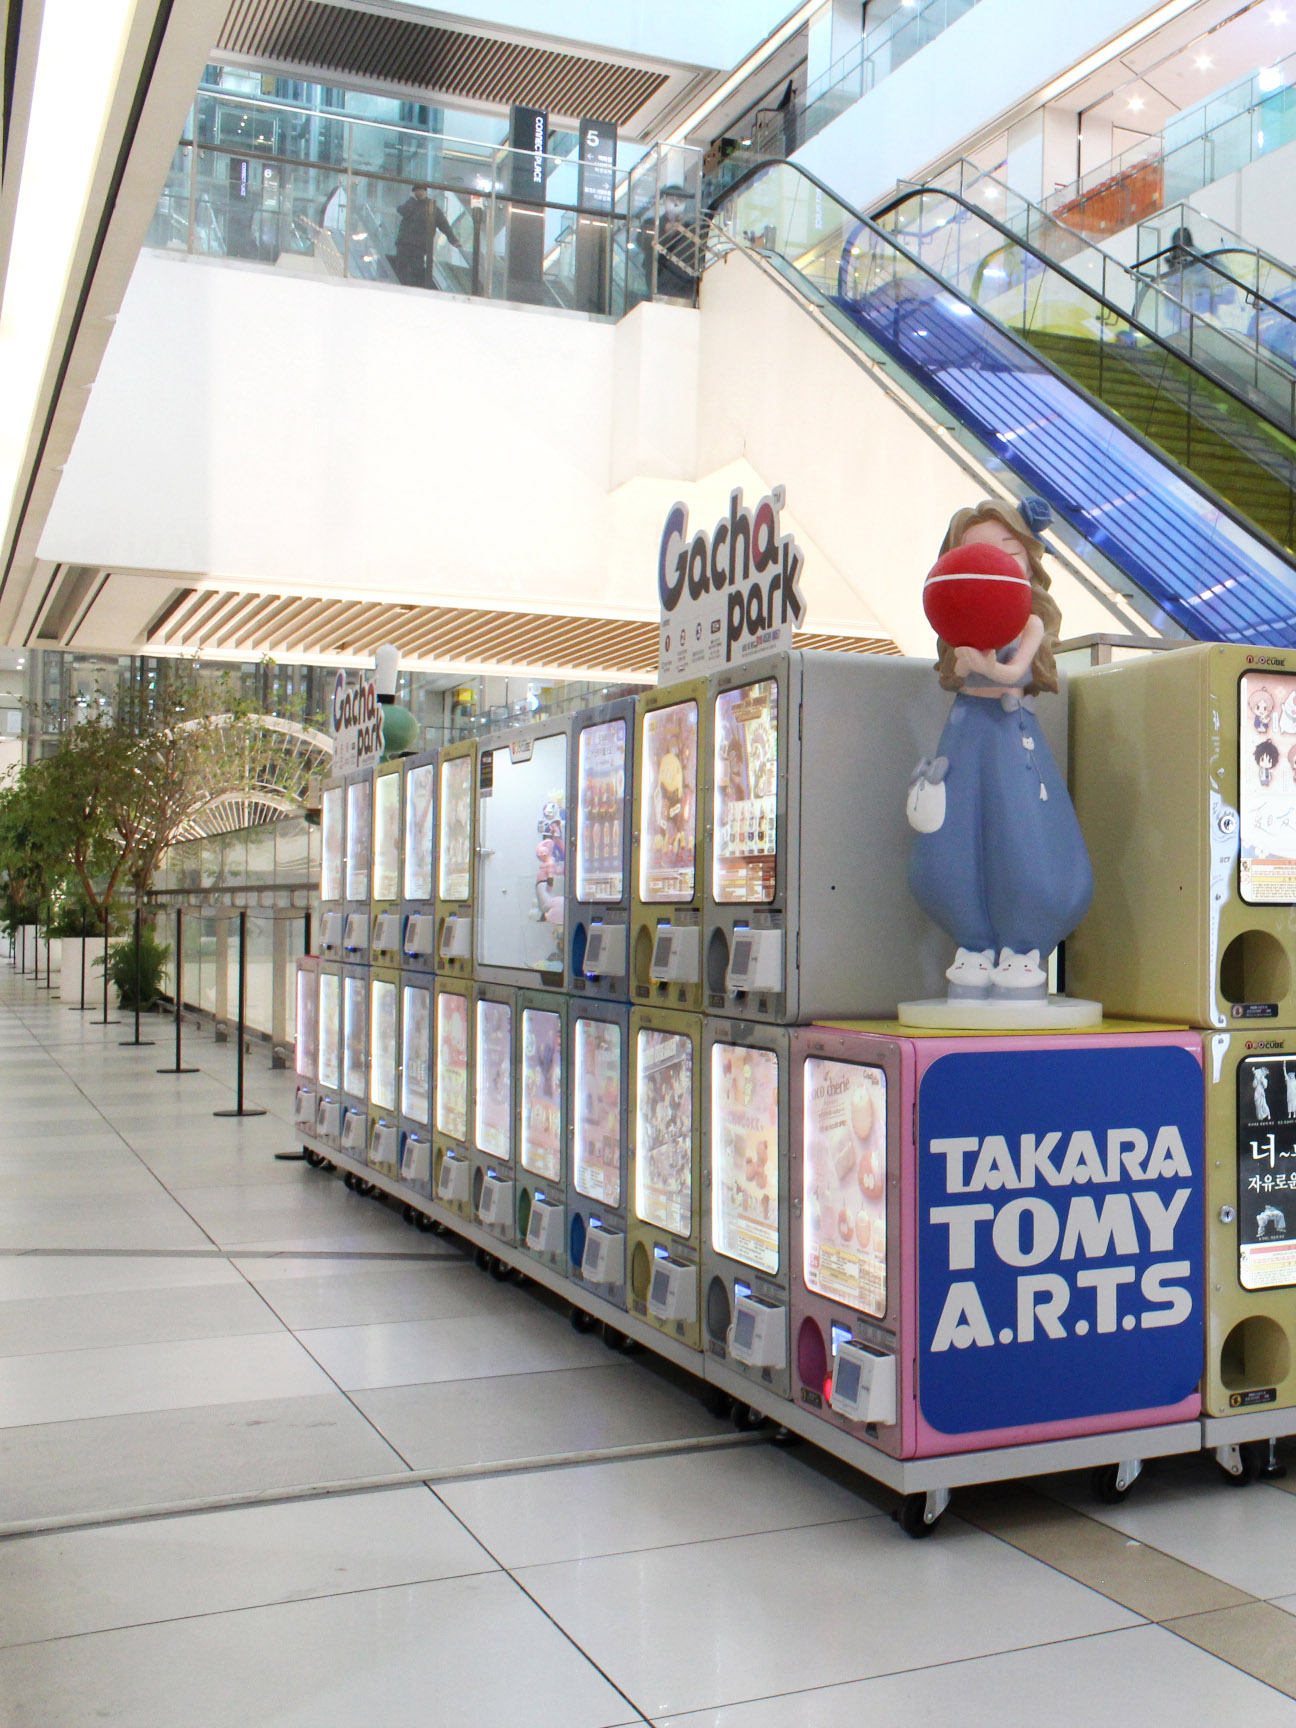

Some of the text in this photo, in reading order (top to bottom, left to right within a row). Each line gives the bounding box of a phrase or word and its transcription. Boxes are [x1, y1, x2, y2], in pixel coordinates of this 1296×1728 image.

[586, 130, 600, 147] 5
[658, 494, 779, 612] Gacha
[726, 542, 801, 662] park
[334, 672, 375, 733] Gacha
[357, 707, 383, 768] park
[1265, 1041, 1284, 1049] CUBE
[930, 1125, 1193, 1194] TAKARA
[930, 1187, 1193, 1271] TOMY
[930, 1260, 1193, 1352] A.R.T.S
